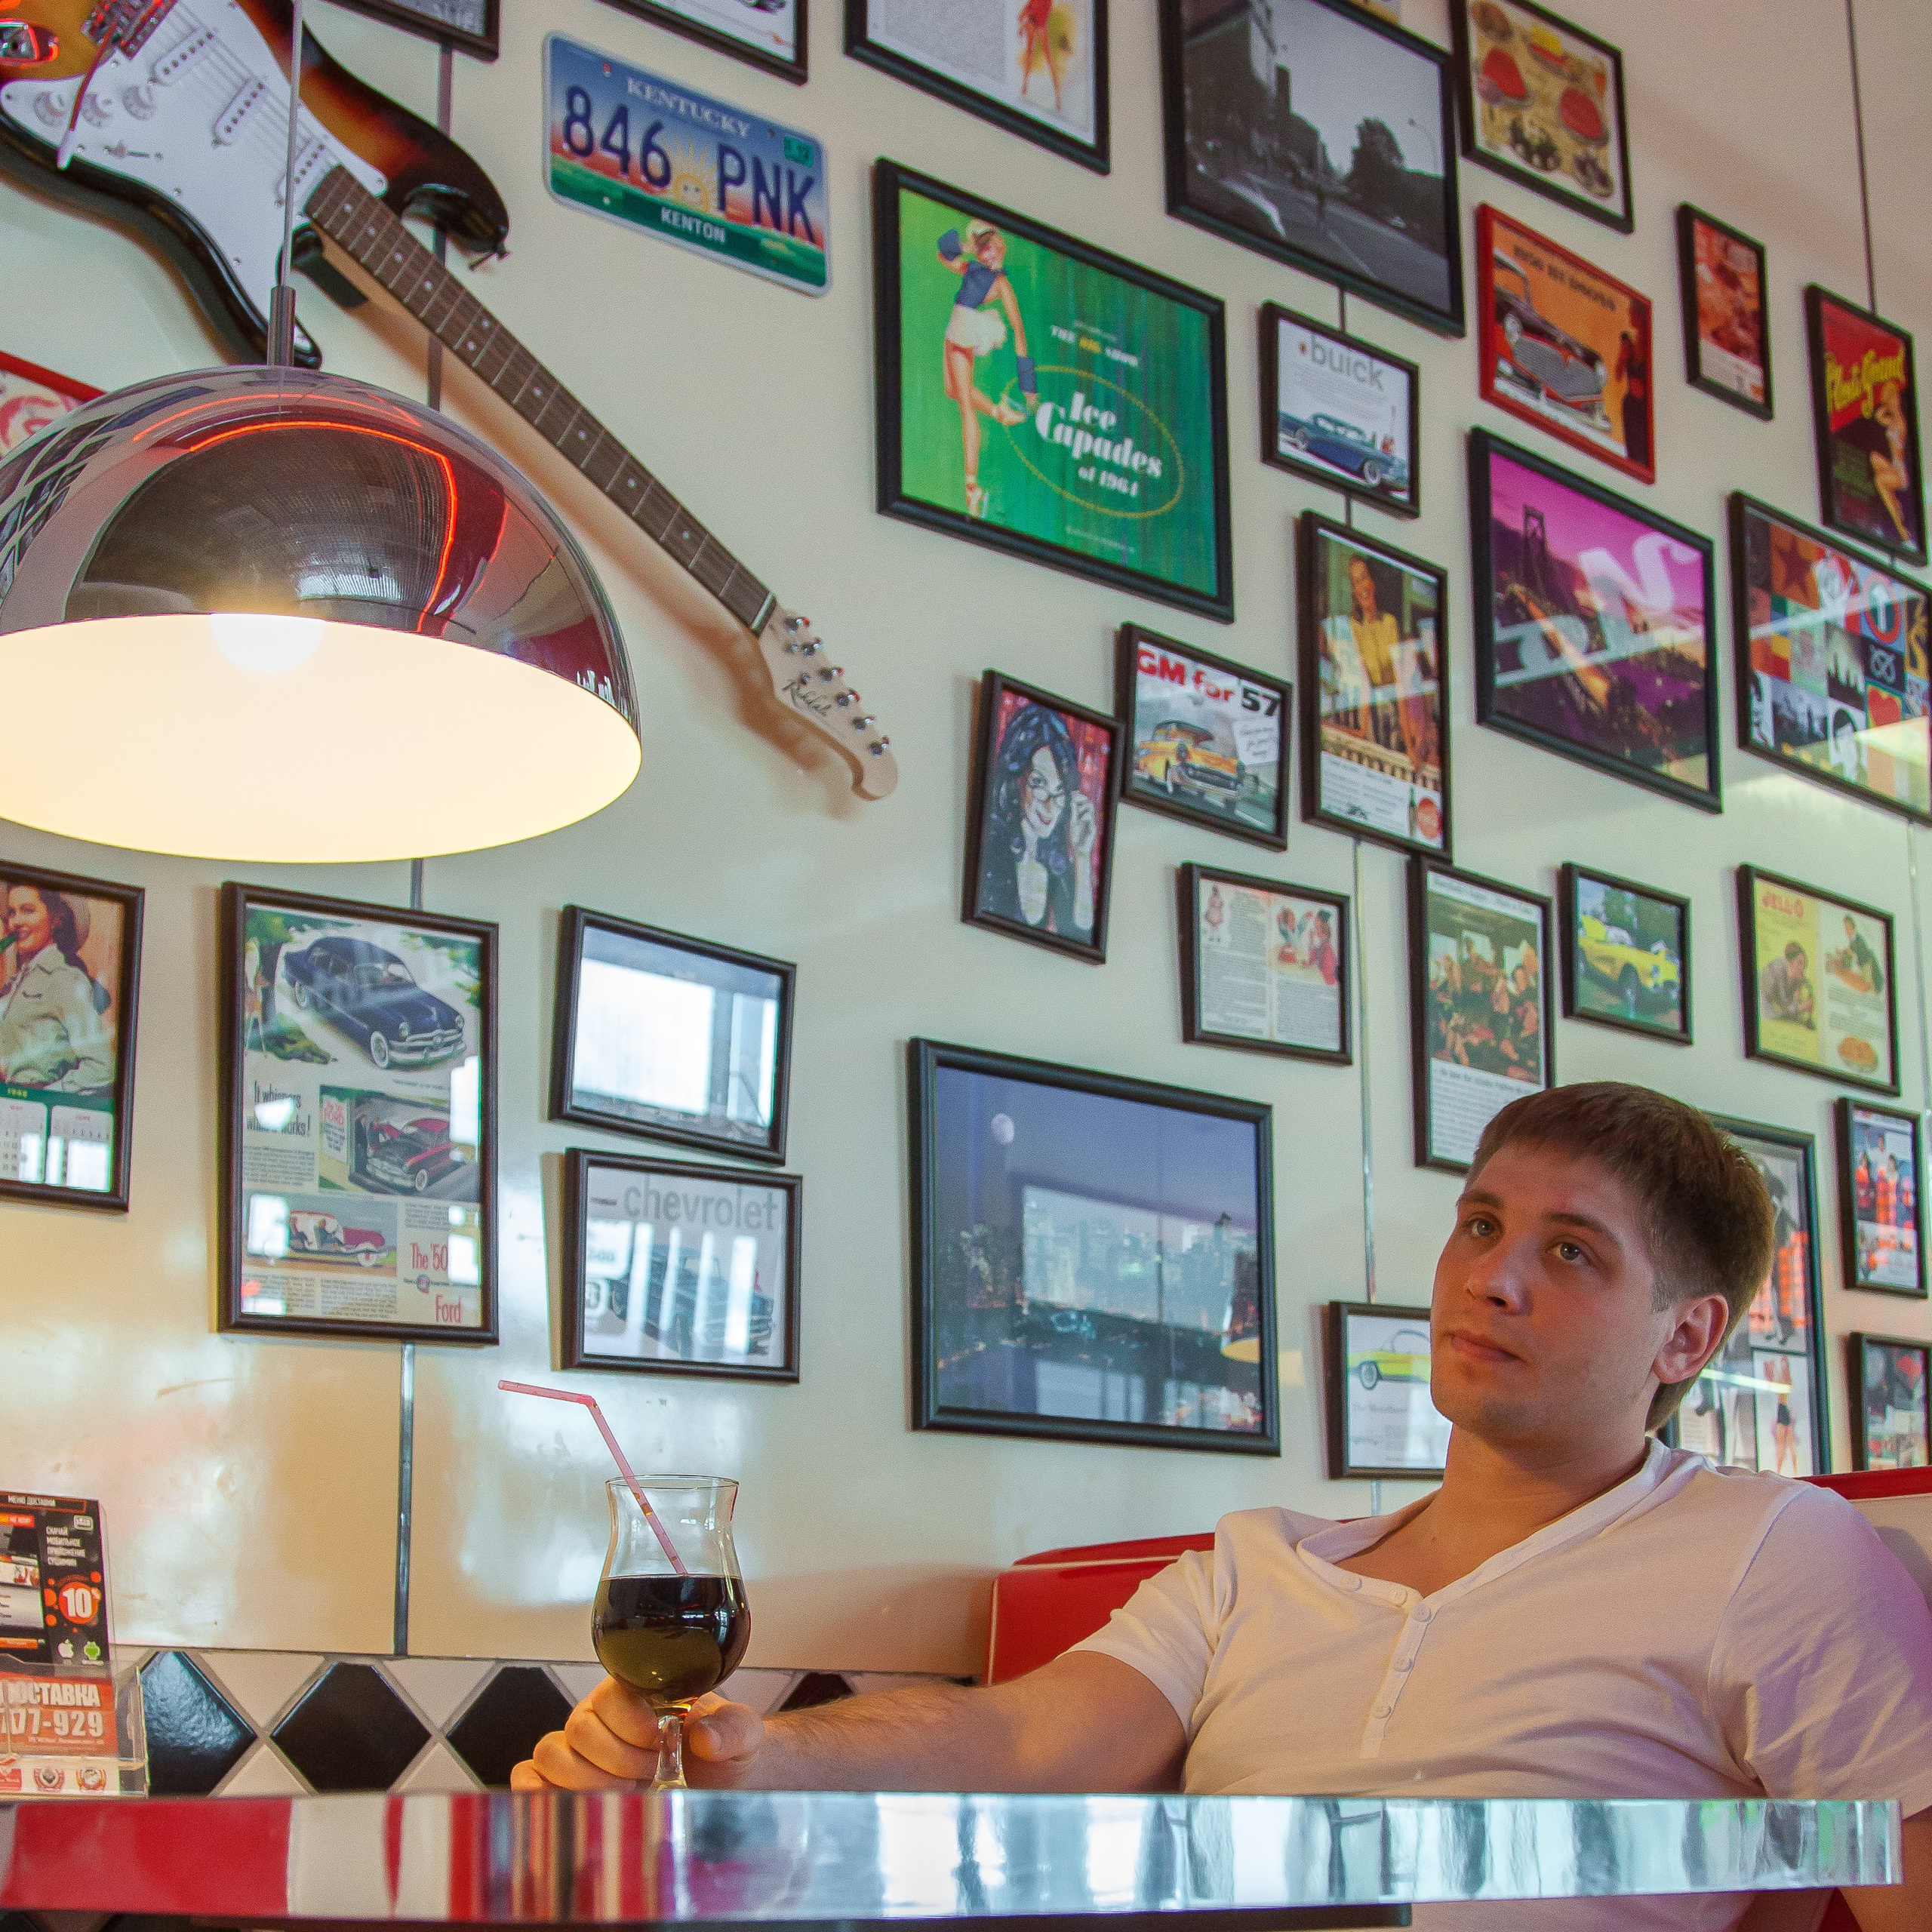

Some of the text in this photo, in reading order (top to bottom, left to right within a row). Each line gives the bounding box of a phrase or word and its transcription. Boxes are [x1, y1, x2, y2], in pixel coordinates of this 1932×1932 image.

[626, 76, 752, 139] KENTUCKY
[563, 85, 817, 244] 846 PNK
[660, 207, 727, 244] KENTON
[1310, 334, 1385, 390] buick
[1069, 391, 1117, 431] Ice
[1035, 401, 1162, 478] Capades
[1078, 466, 1096, 482] of
[1137, 648, 1186, 685] GM
[254, 1080, 260, 1103] It
[623, 1174, 778, 1230] chevrolet
[411, 1241, 429, 1271] The
[435, 1293, 463, 1323] Ford
